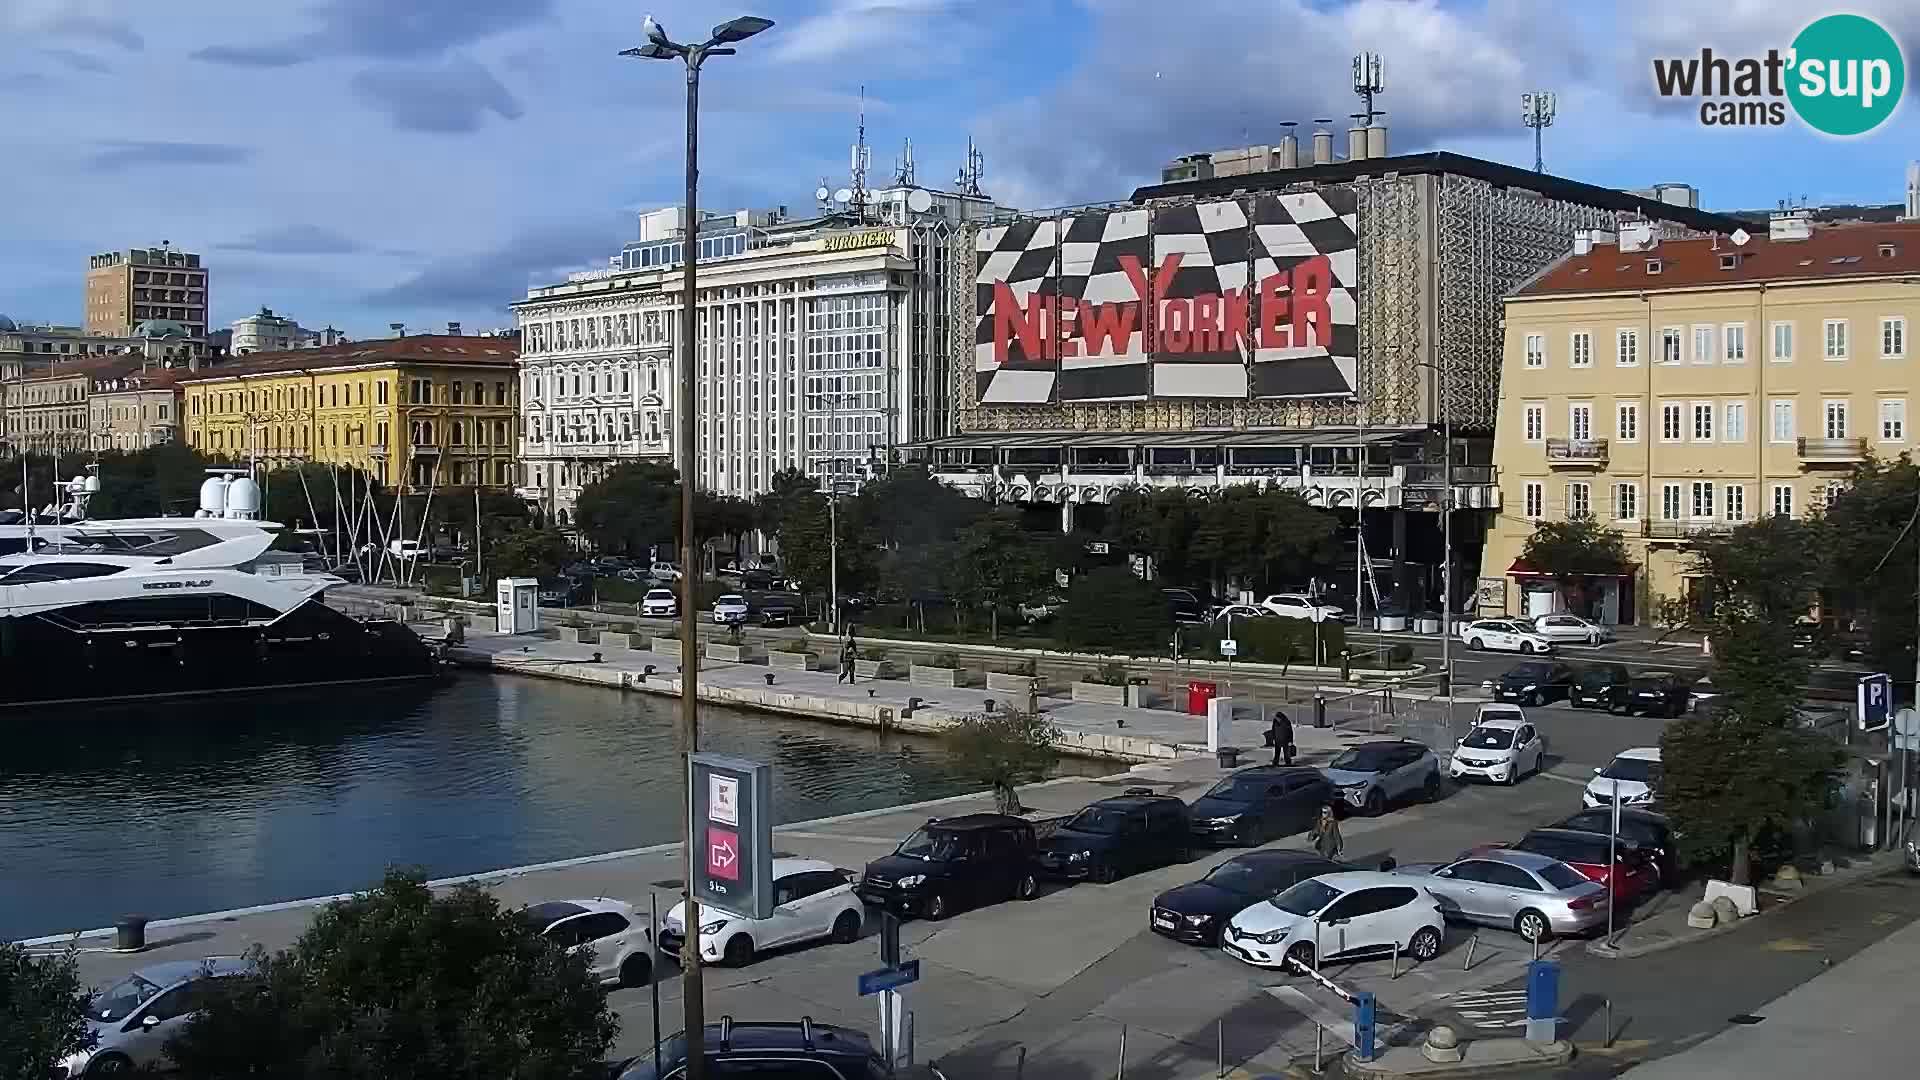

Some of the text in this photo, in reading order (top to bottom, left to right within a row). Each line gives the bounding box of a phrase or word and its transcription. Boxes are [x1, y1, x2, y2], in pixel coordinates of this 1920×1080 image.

[994, 252, 1332, 362] NEW YORKER
[1870, 683, 1882, 706] P
